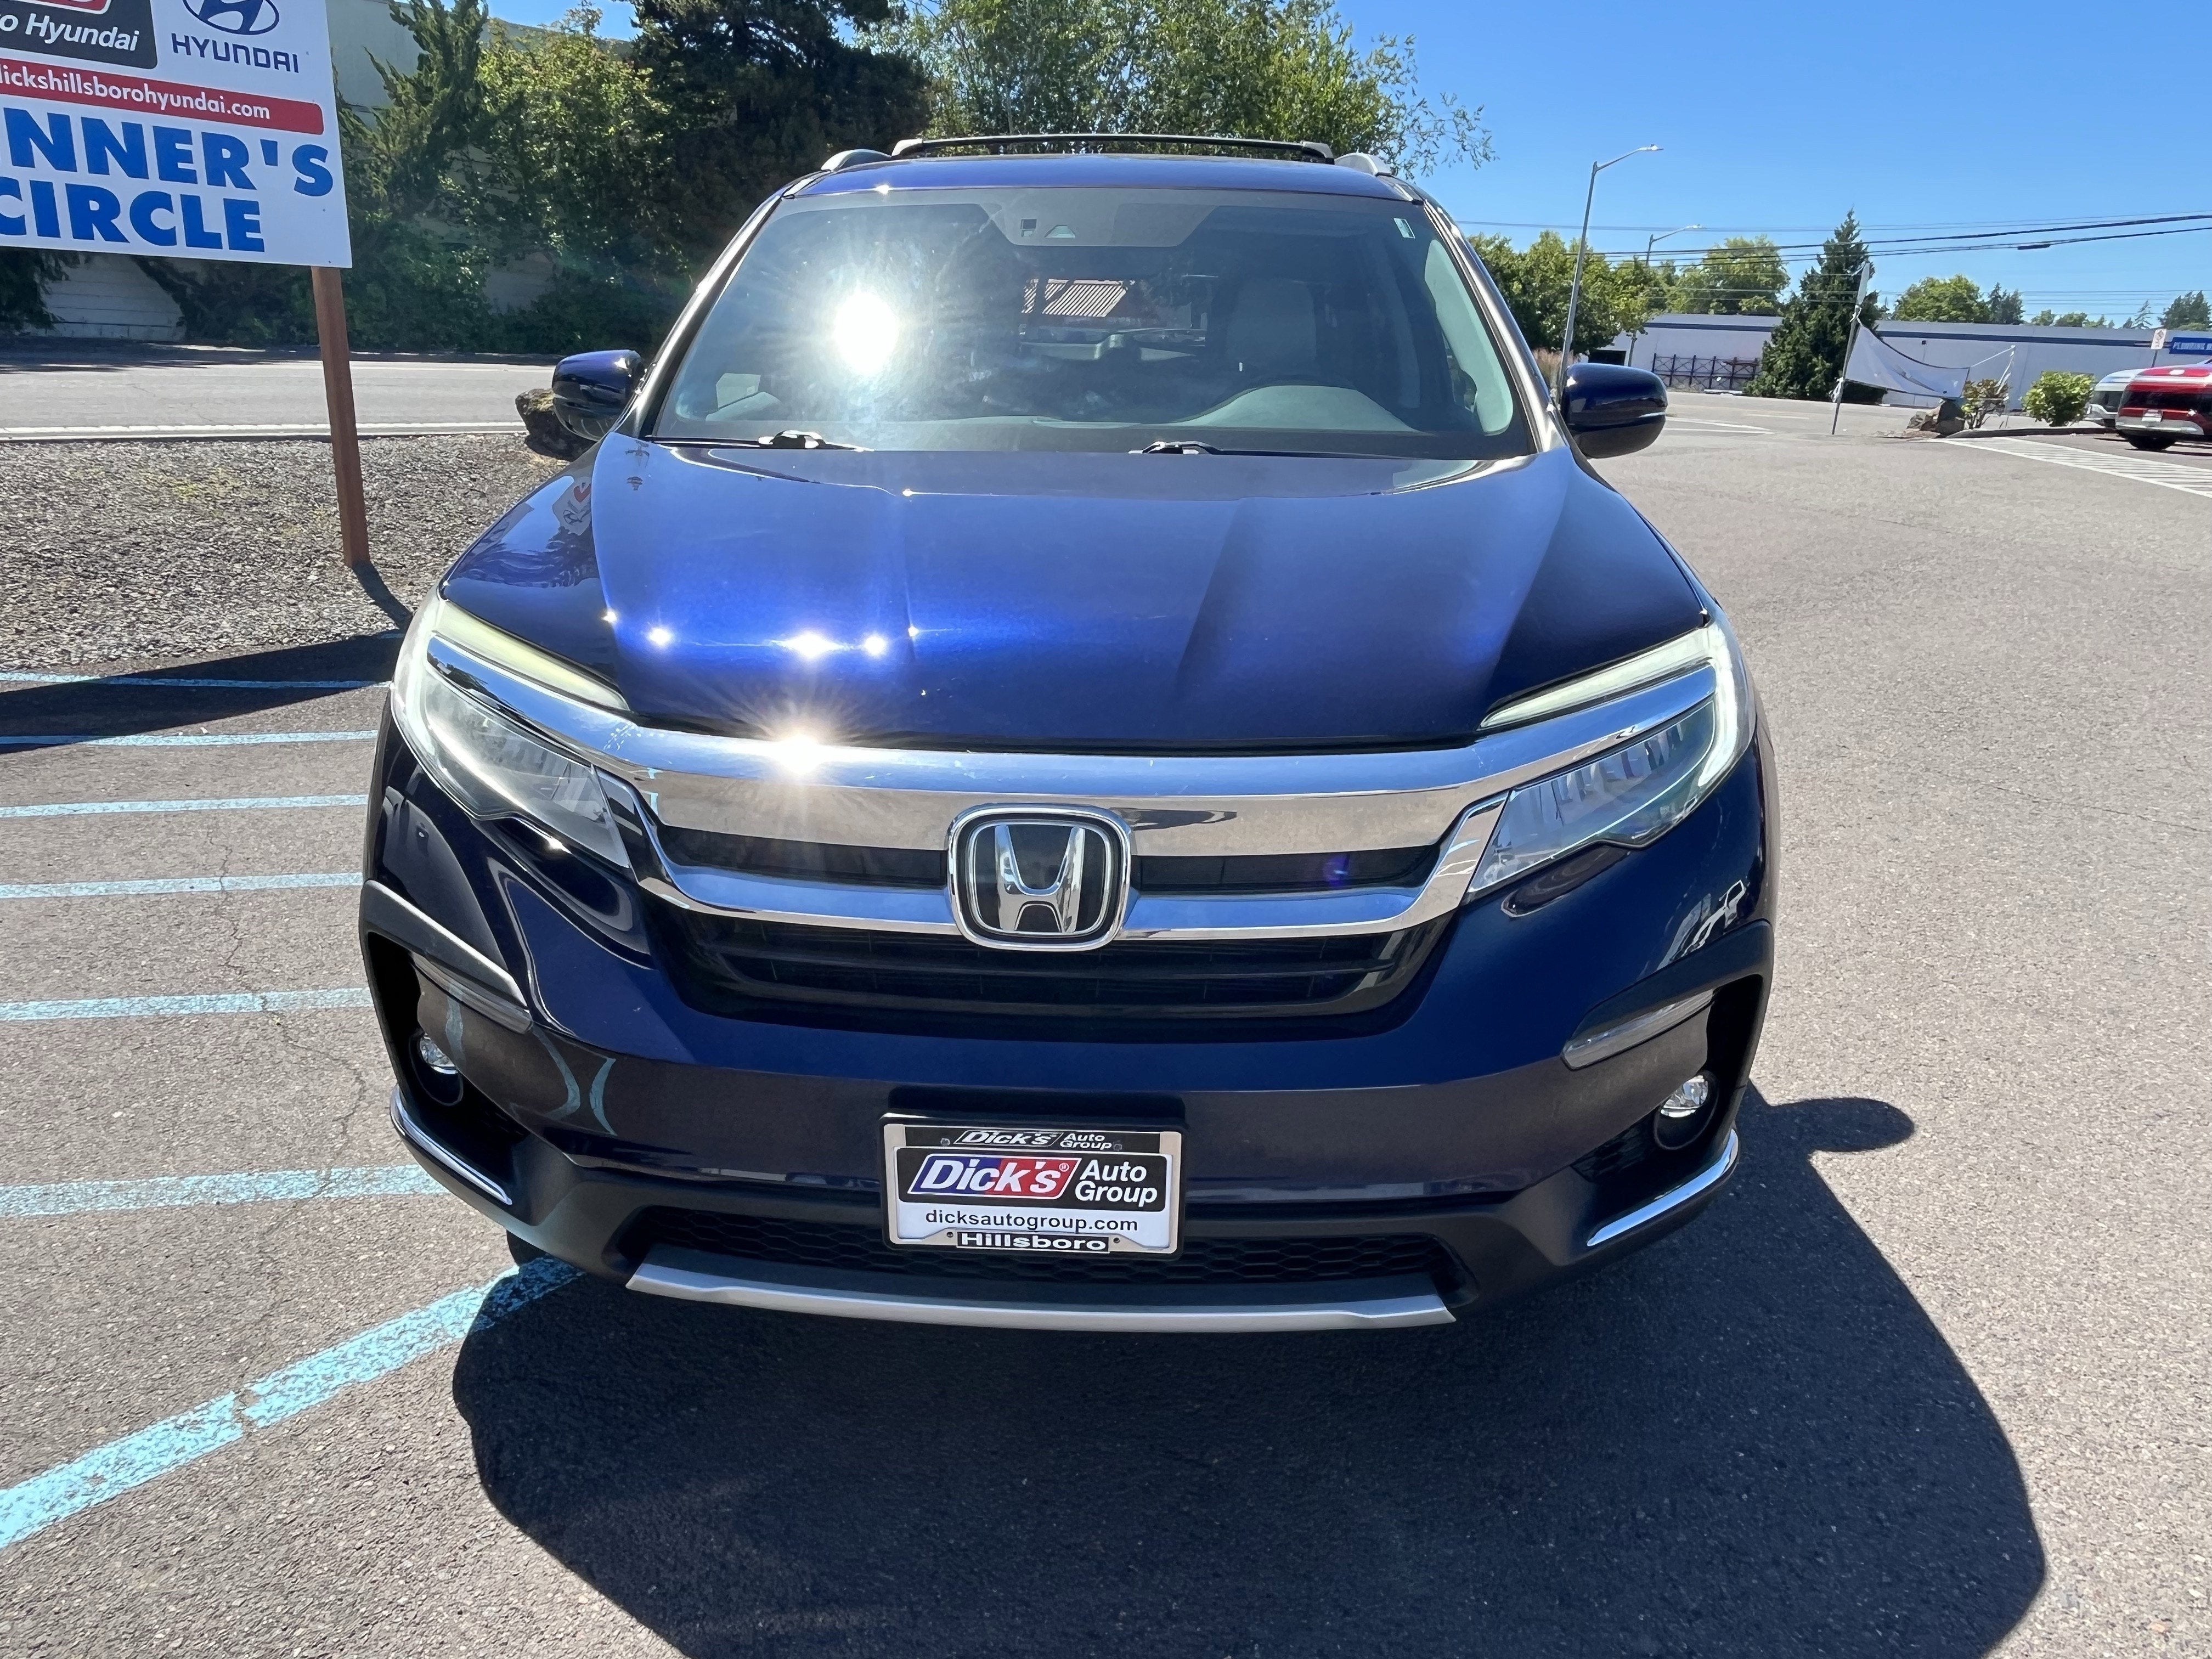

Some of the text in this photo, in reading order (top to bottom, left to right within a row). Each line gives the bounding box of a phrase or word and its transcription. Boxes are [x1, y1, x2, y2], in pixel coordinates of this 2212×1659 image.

[0, 13, 139, 51] o Hyundai
[171, 33, 299, 73] HYUNDAI
[0, 64, 270, 119] ickshillsborohyundai.com
[4, 108, 333, 196] NNER'S
[0, 177, 264, 252] CIRCLE
[962, 1132, 1052, 1145] Dick's
[1060, 1141, 1112, 1150] Group
[1064, 1133, 1105, 1142] Auto
[920, 1159, 1060, 1193] Dick's
[1080, 1159, 1147, 1182] Auto
[1075, 1181, 1158, 1207] Group
[926, 1210, 1137, 1233] dicksautogroup.com
[961, 1233, 1107, 1250] Hillsboro
